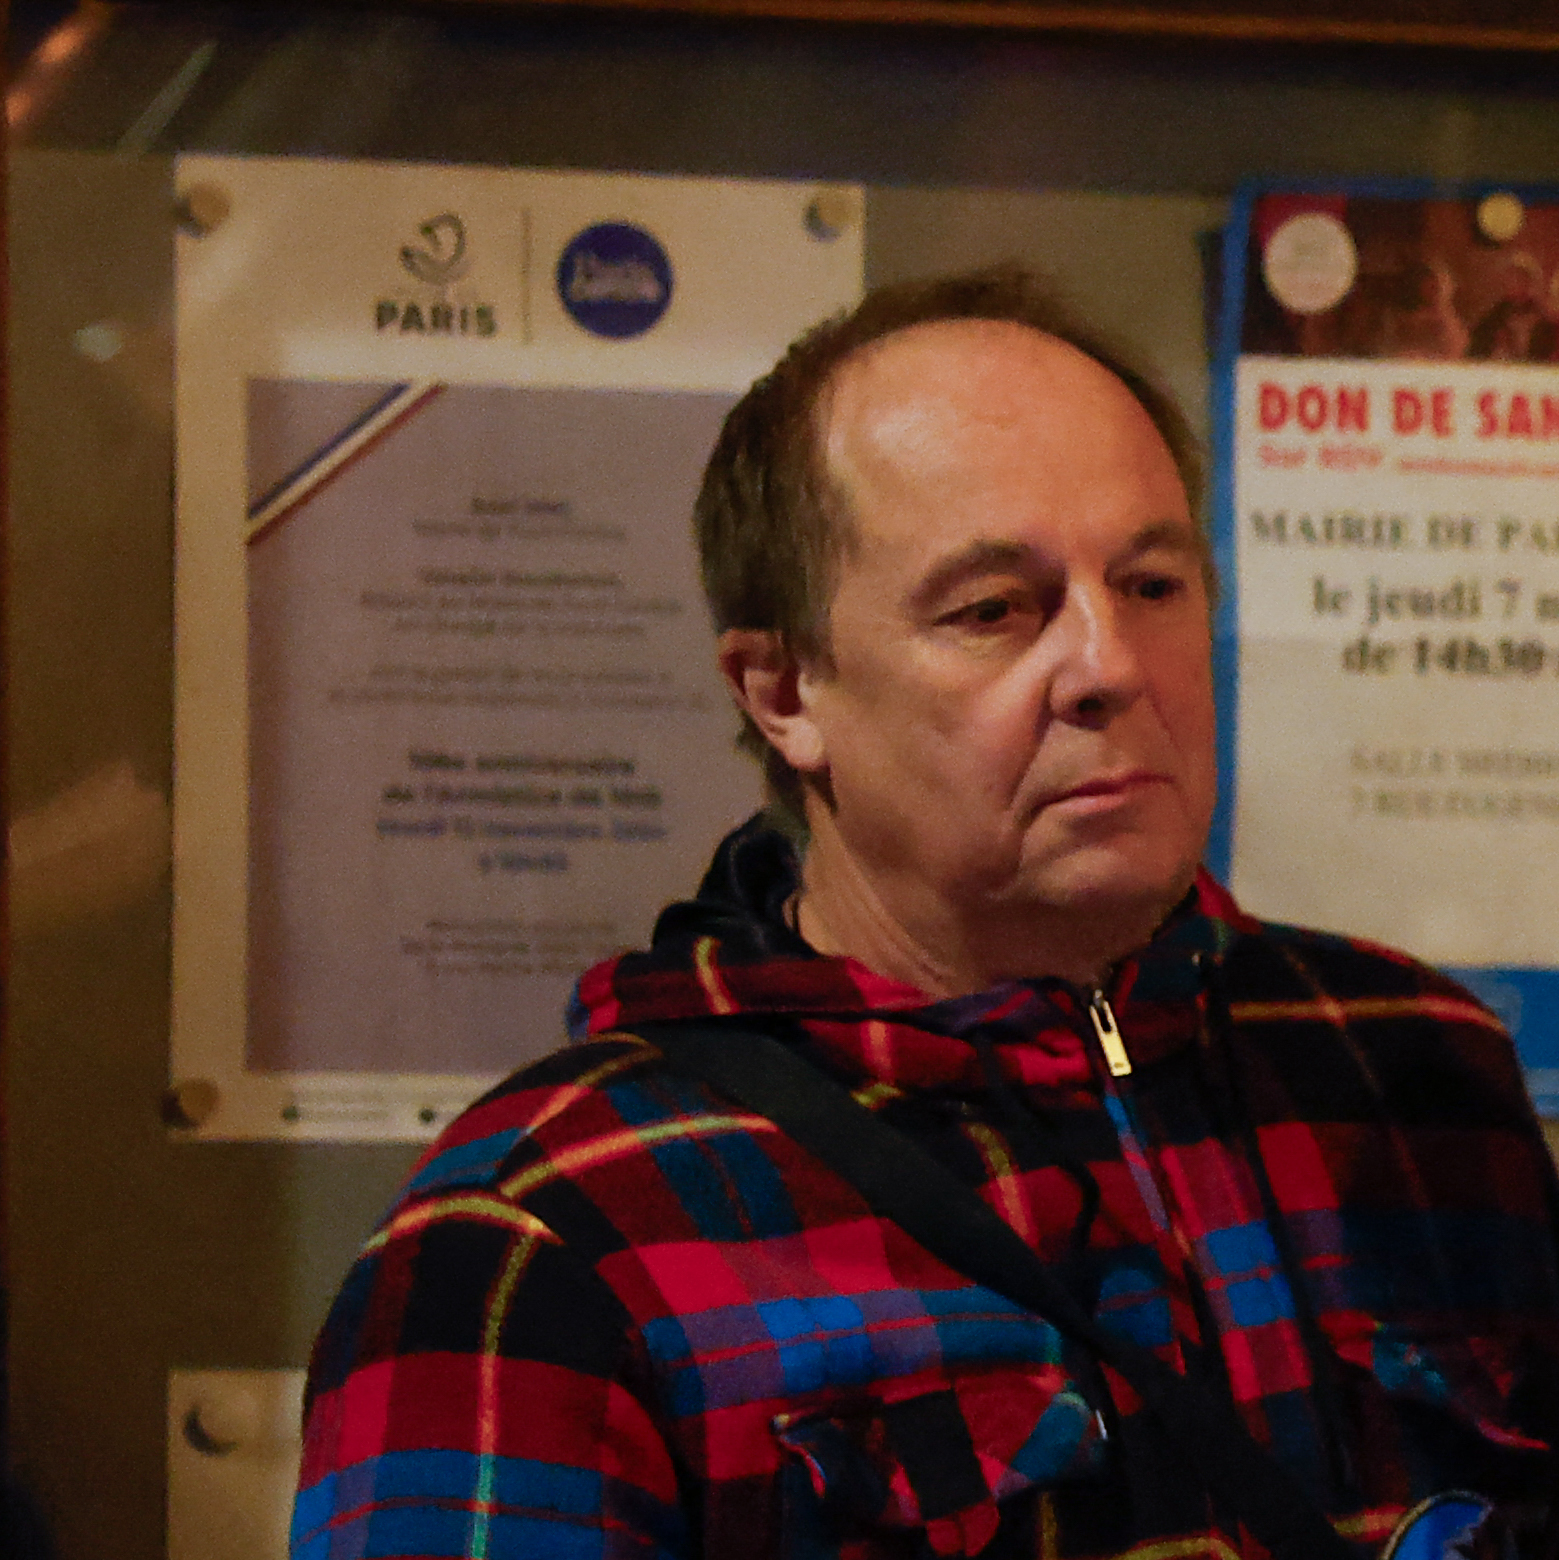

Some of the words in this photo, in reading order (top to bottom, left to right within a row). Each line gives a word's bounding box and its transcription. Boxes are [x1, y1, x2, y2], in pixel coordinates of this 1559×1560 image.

[376, 301, 498, 337] PARIS
[1258, 382, 1369, 433] DON
[1391, 387, 1454, 438] DE
[1251, 510, 1409, 548] MAIRIE
[1427, 517, 1478, 551] DE
[1311, 575, 1352, 618] le
[1364, 576, 1482, 628] jeudi
[1341, 637, 1396, 676] de
[1411, 637, 1546, 678] 14h30
